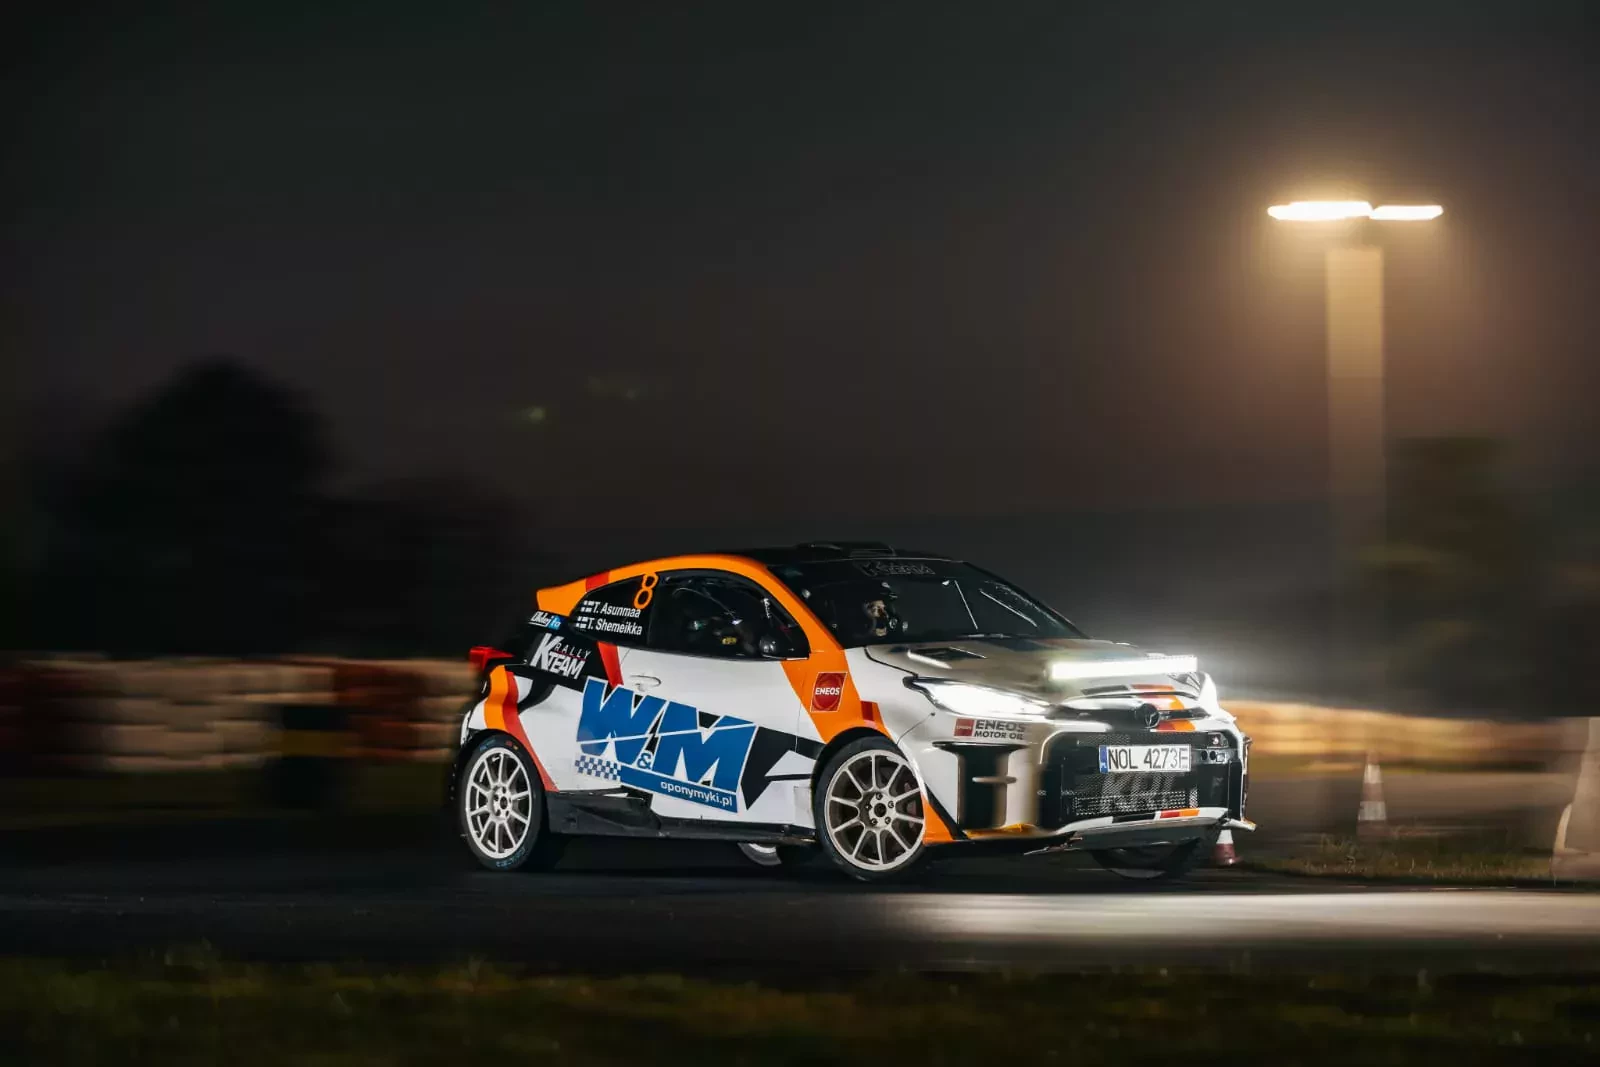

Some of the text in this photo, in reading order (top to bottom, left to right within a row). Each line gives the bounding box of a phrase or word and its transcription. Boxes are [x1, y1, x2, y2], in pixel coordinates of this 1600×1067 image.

[633, 572, 659, 609] 8
[592, 601, 642, 618] T. Asunmaa
[587, 617, 643, 636] T. Shemeikka
[555, 642, 592, 659] RALLY
[815, 687, 841, 696] ENEOS
[974, 730, 1007, 739] MOTOR
[975, 719, 1026, 733] ENEOS
[1108, 748, 1138, 770] NOL
[660, 780, 733, 807] oponymyki.pl
